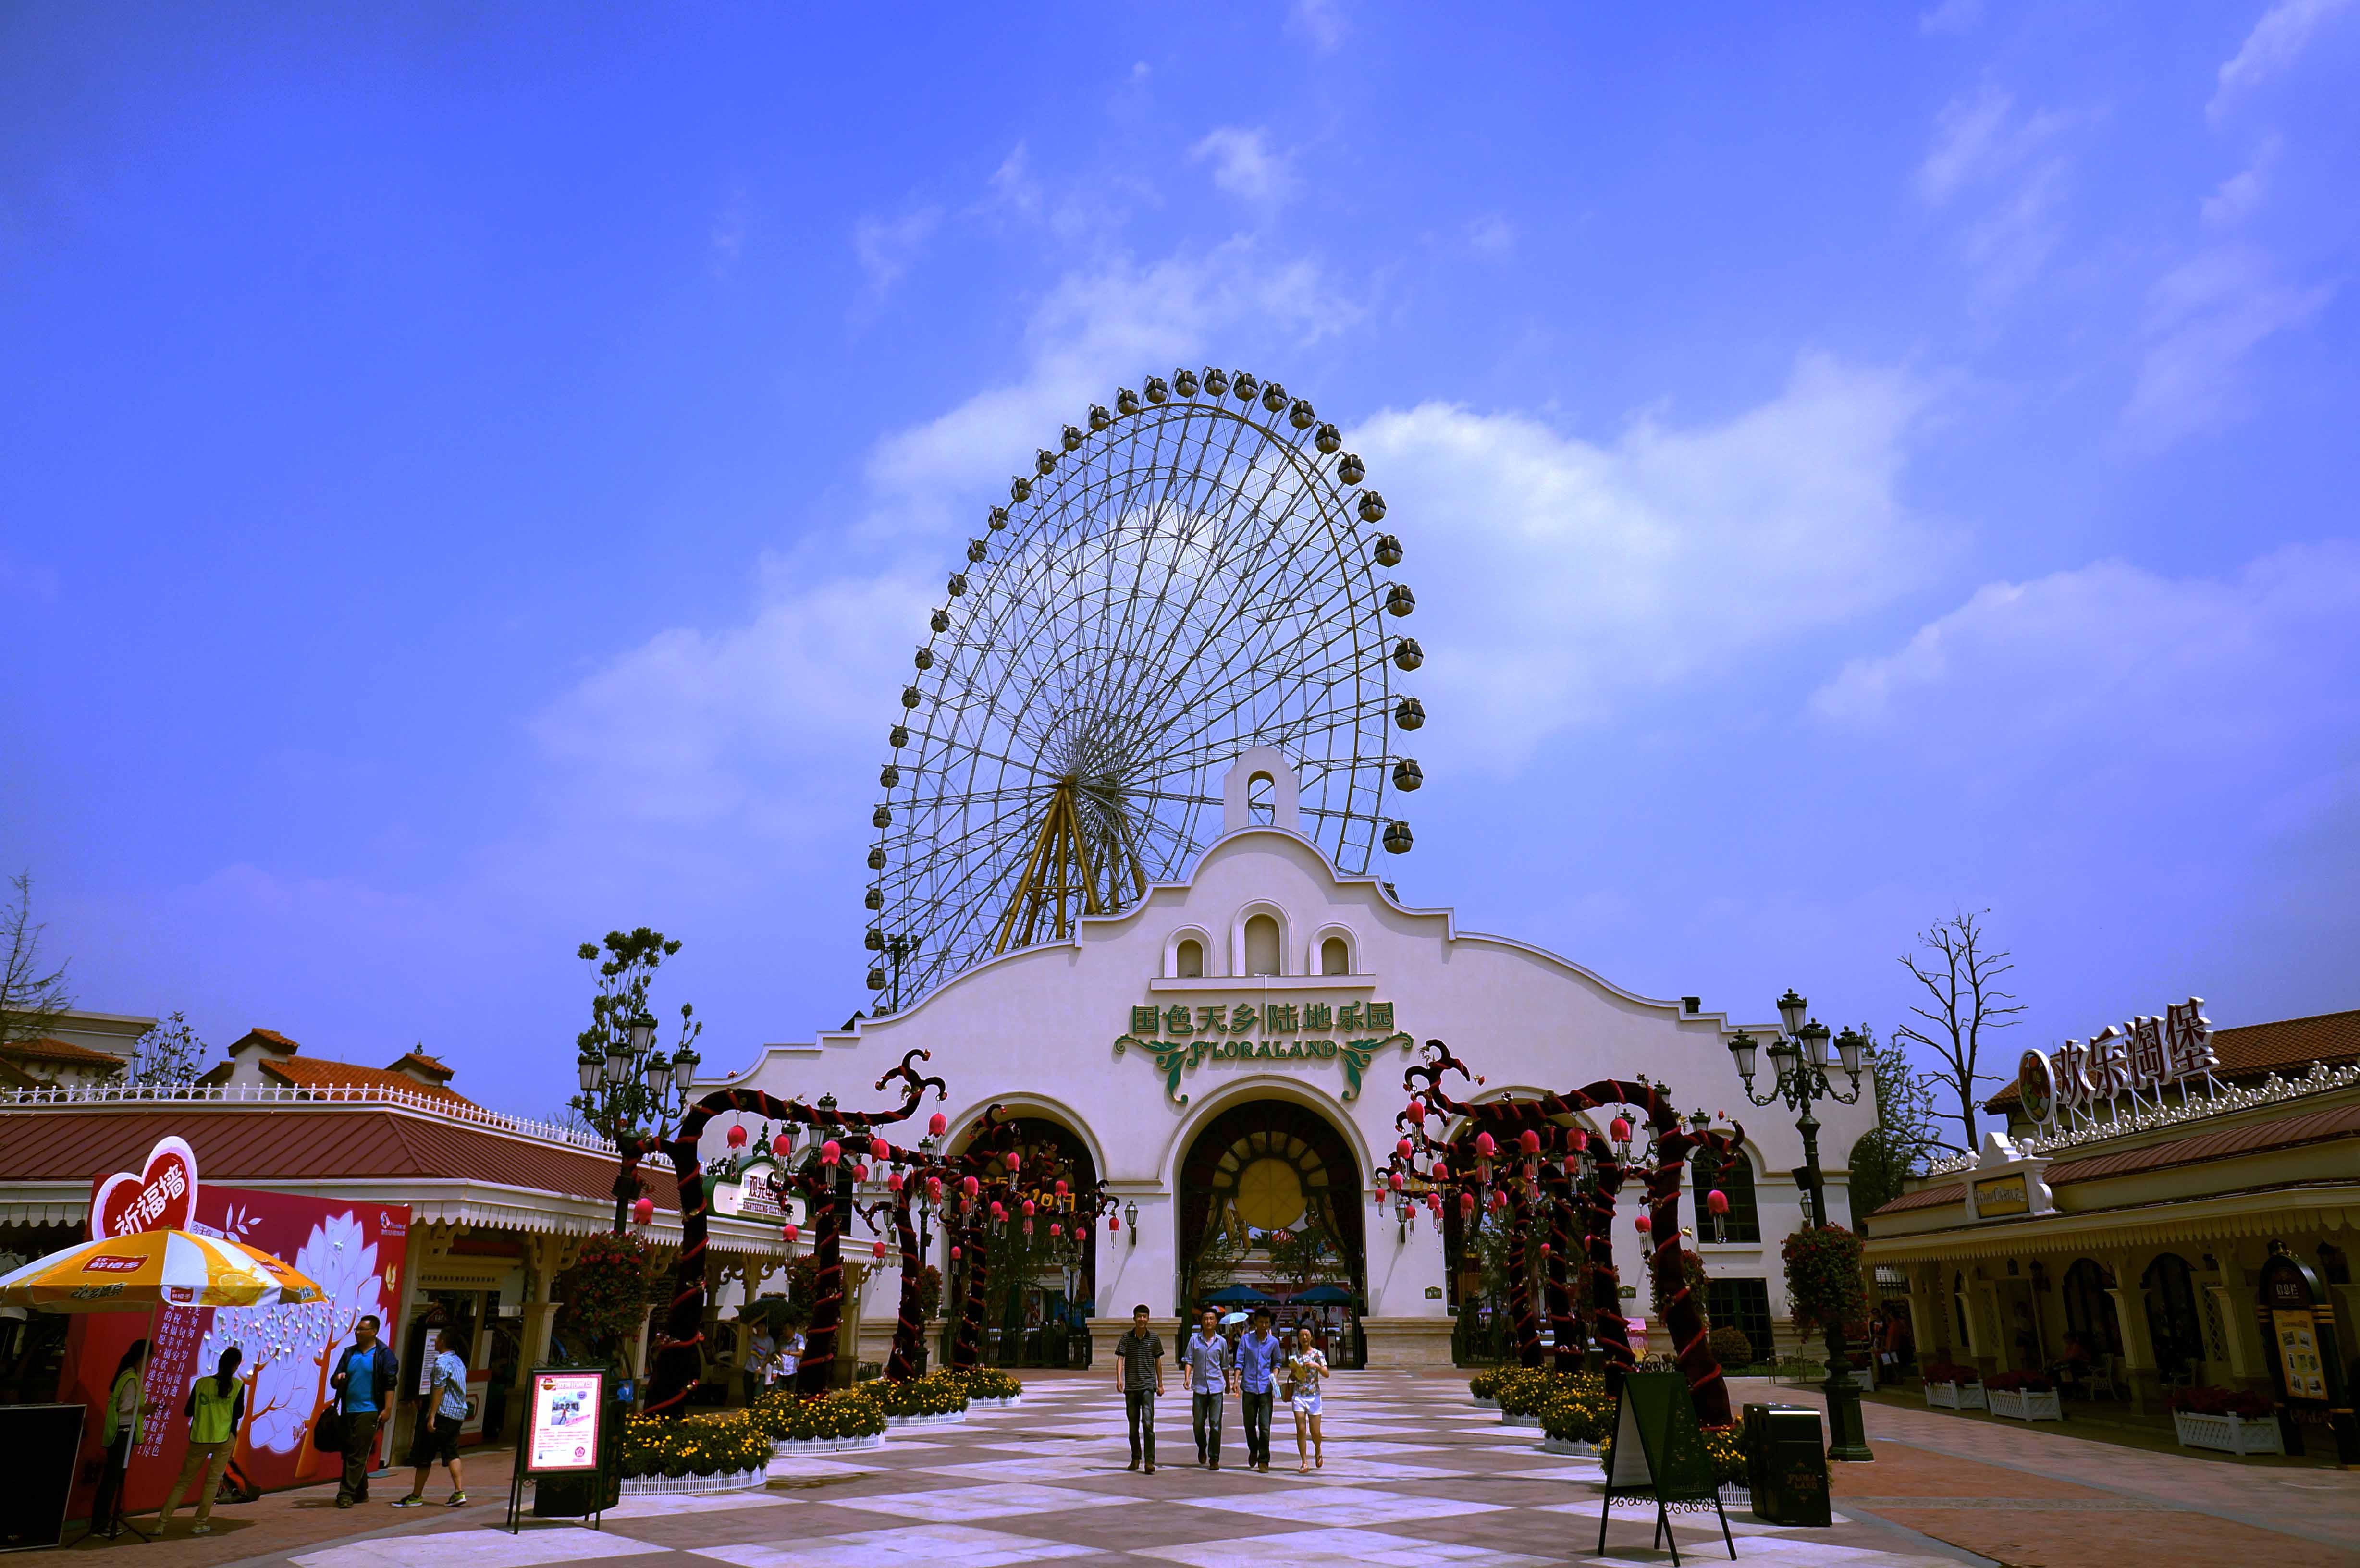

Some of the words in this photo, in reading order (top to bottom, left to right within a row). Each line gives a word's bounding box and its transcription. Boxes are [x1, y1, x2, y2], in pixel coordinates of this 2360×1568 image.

[1187, 1041, 1338, 1067] FLORALAND
[2050, 997, 2220, 1109] 欢乐淘堡
[115, 1164, 185, 1236] 祈福墙
[743, 1200, 768, 1213] SIGHTSEEING
